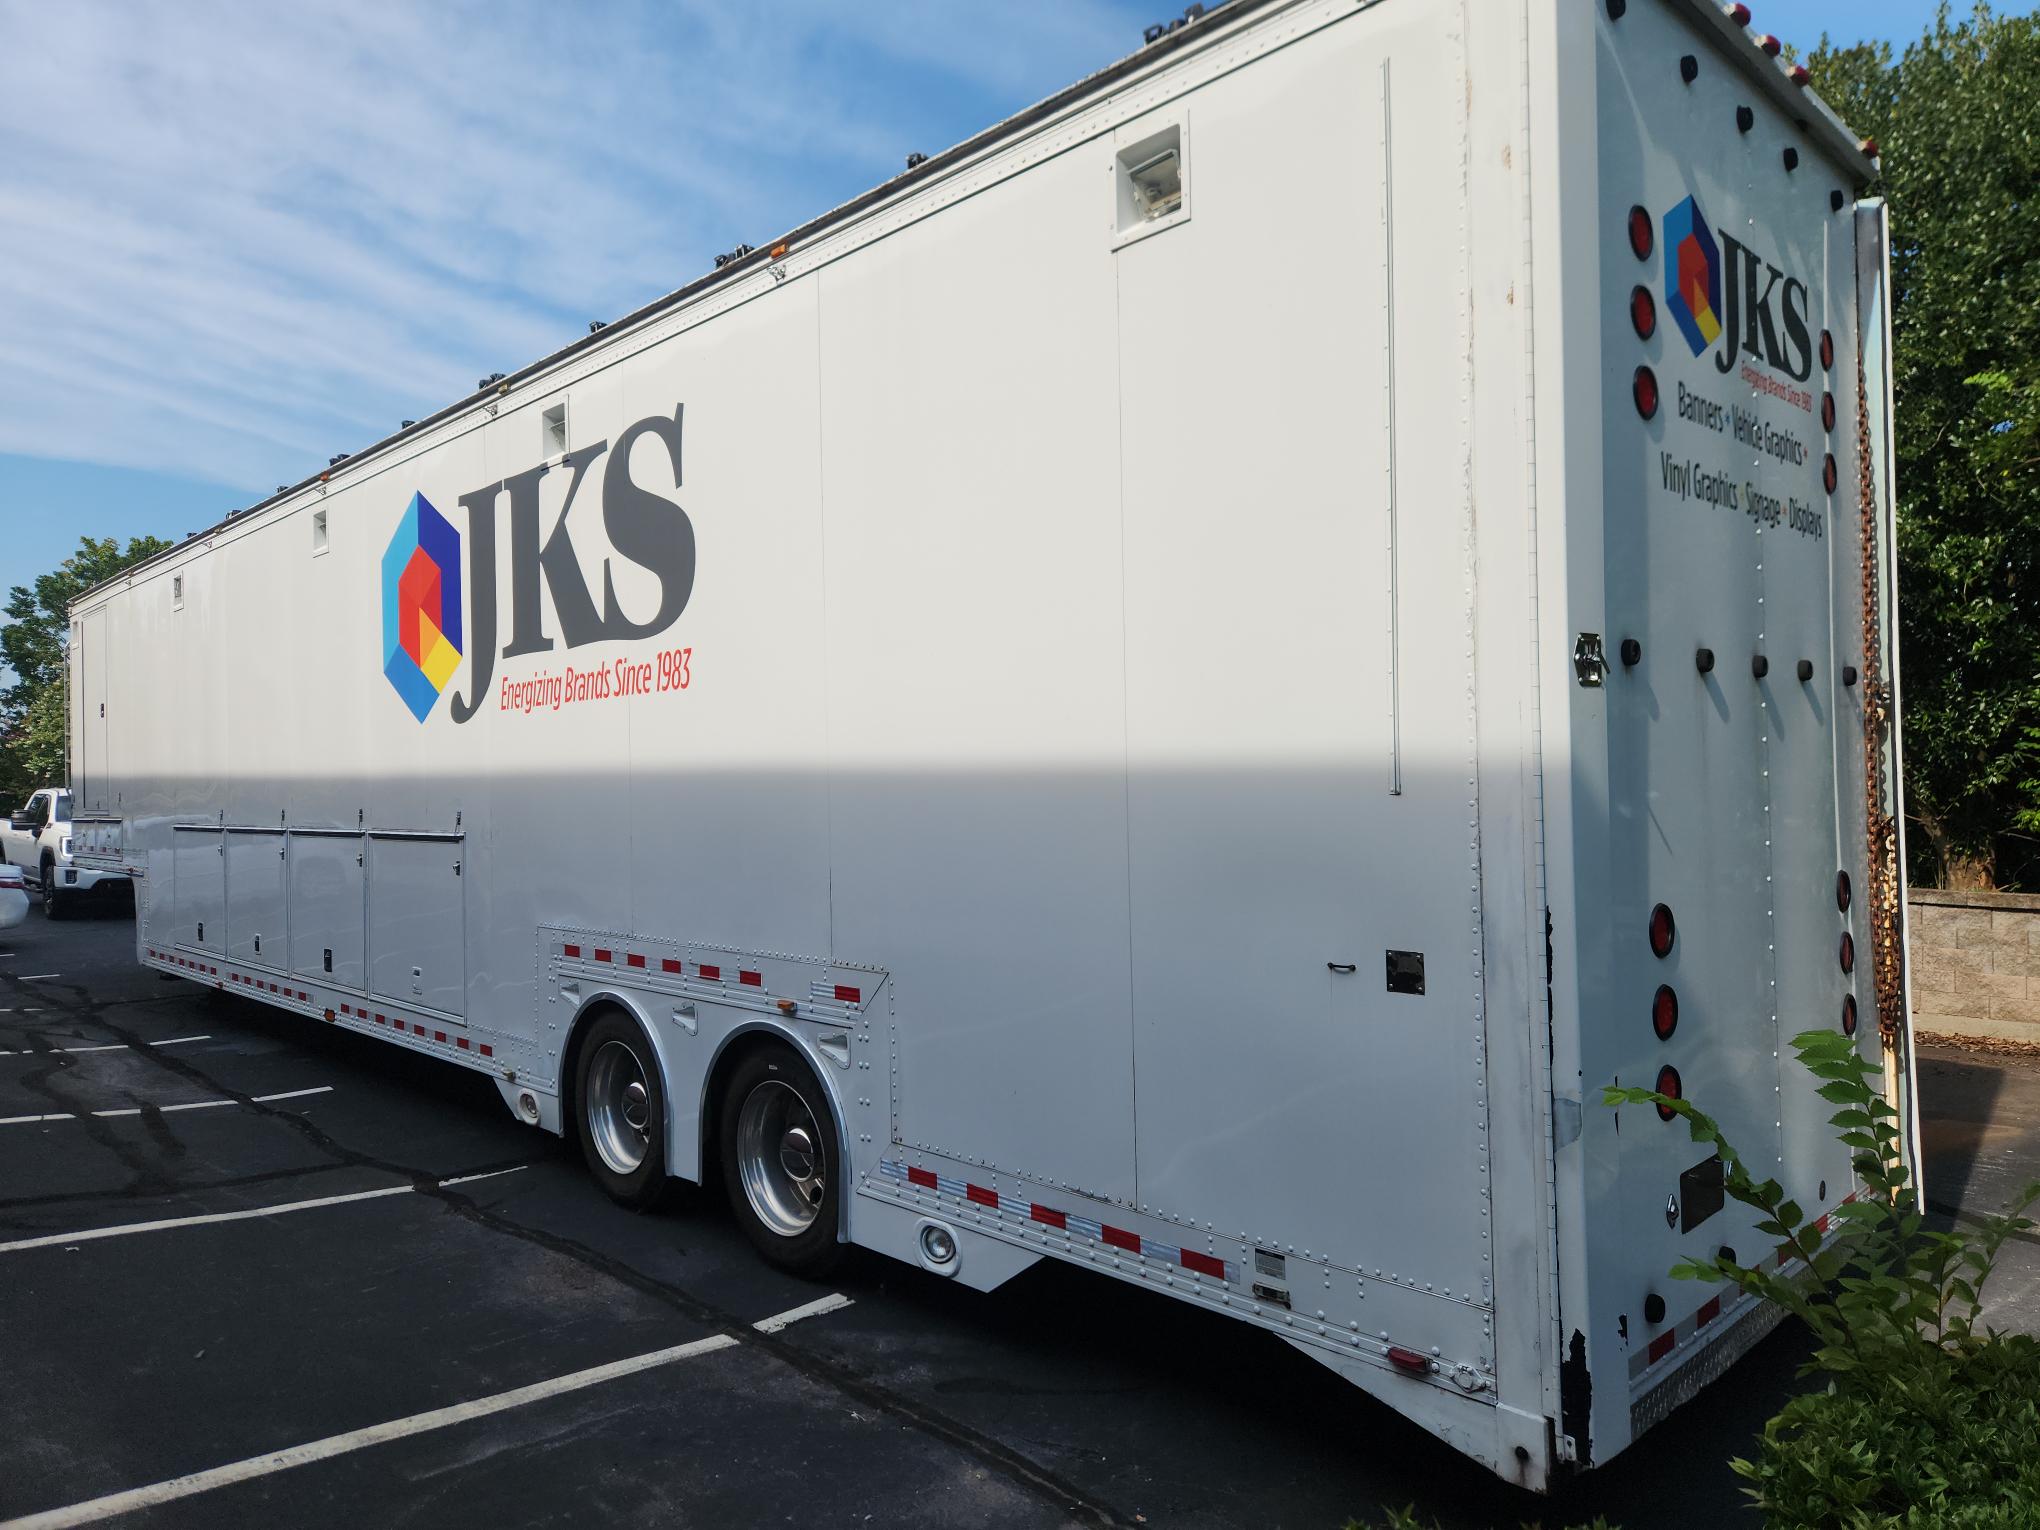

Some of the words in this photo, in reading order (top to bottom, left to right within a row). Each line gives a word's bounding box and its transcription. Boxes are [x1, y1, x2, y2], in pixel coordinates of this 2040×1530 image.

[1715, 228, 1812, 382] JKS
[1678, 381, 1723, 433] Banners
[1731, 403, 1763, 451] Vehicle
[1764, 421, 1803, 466] Graphics
[1660, 450, 1691, 501] Vinyl
[1693, 462, 1738, 511] Graphics
[1745, 481, 1781, 529] Signage
[1789, 497, 1823, 542] Displays
[451, 402, 696, 724] JKS
[500, 670, 562, 714] Energizing
[564, 661, 611, 703] Brands
[613, 657, 652, 697] Since
[656, 647, 692, 693] 1983
